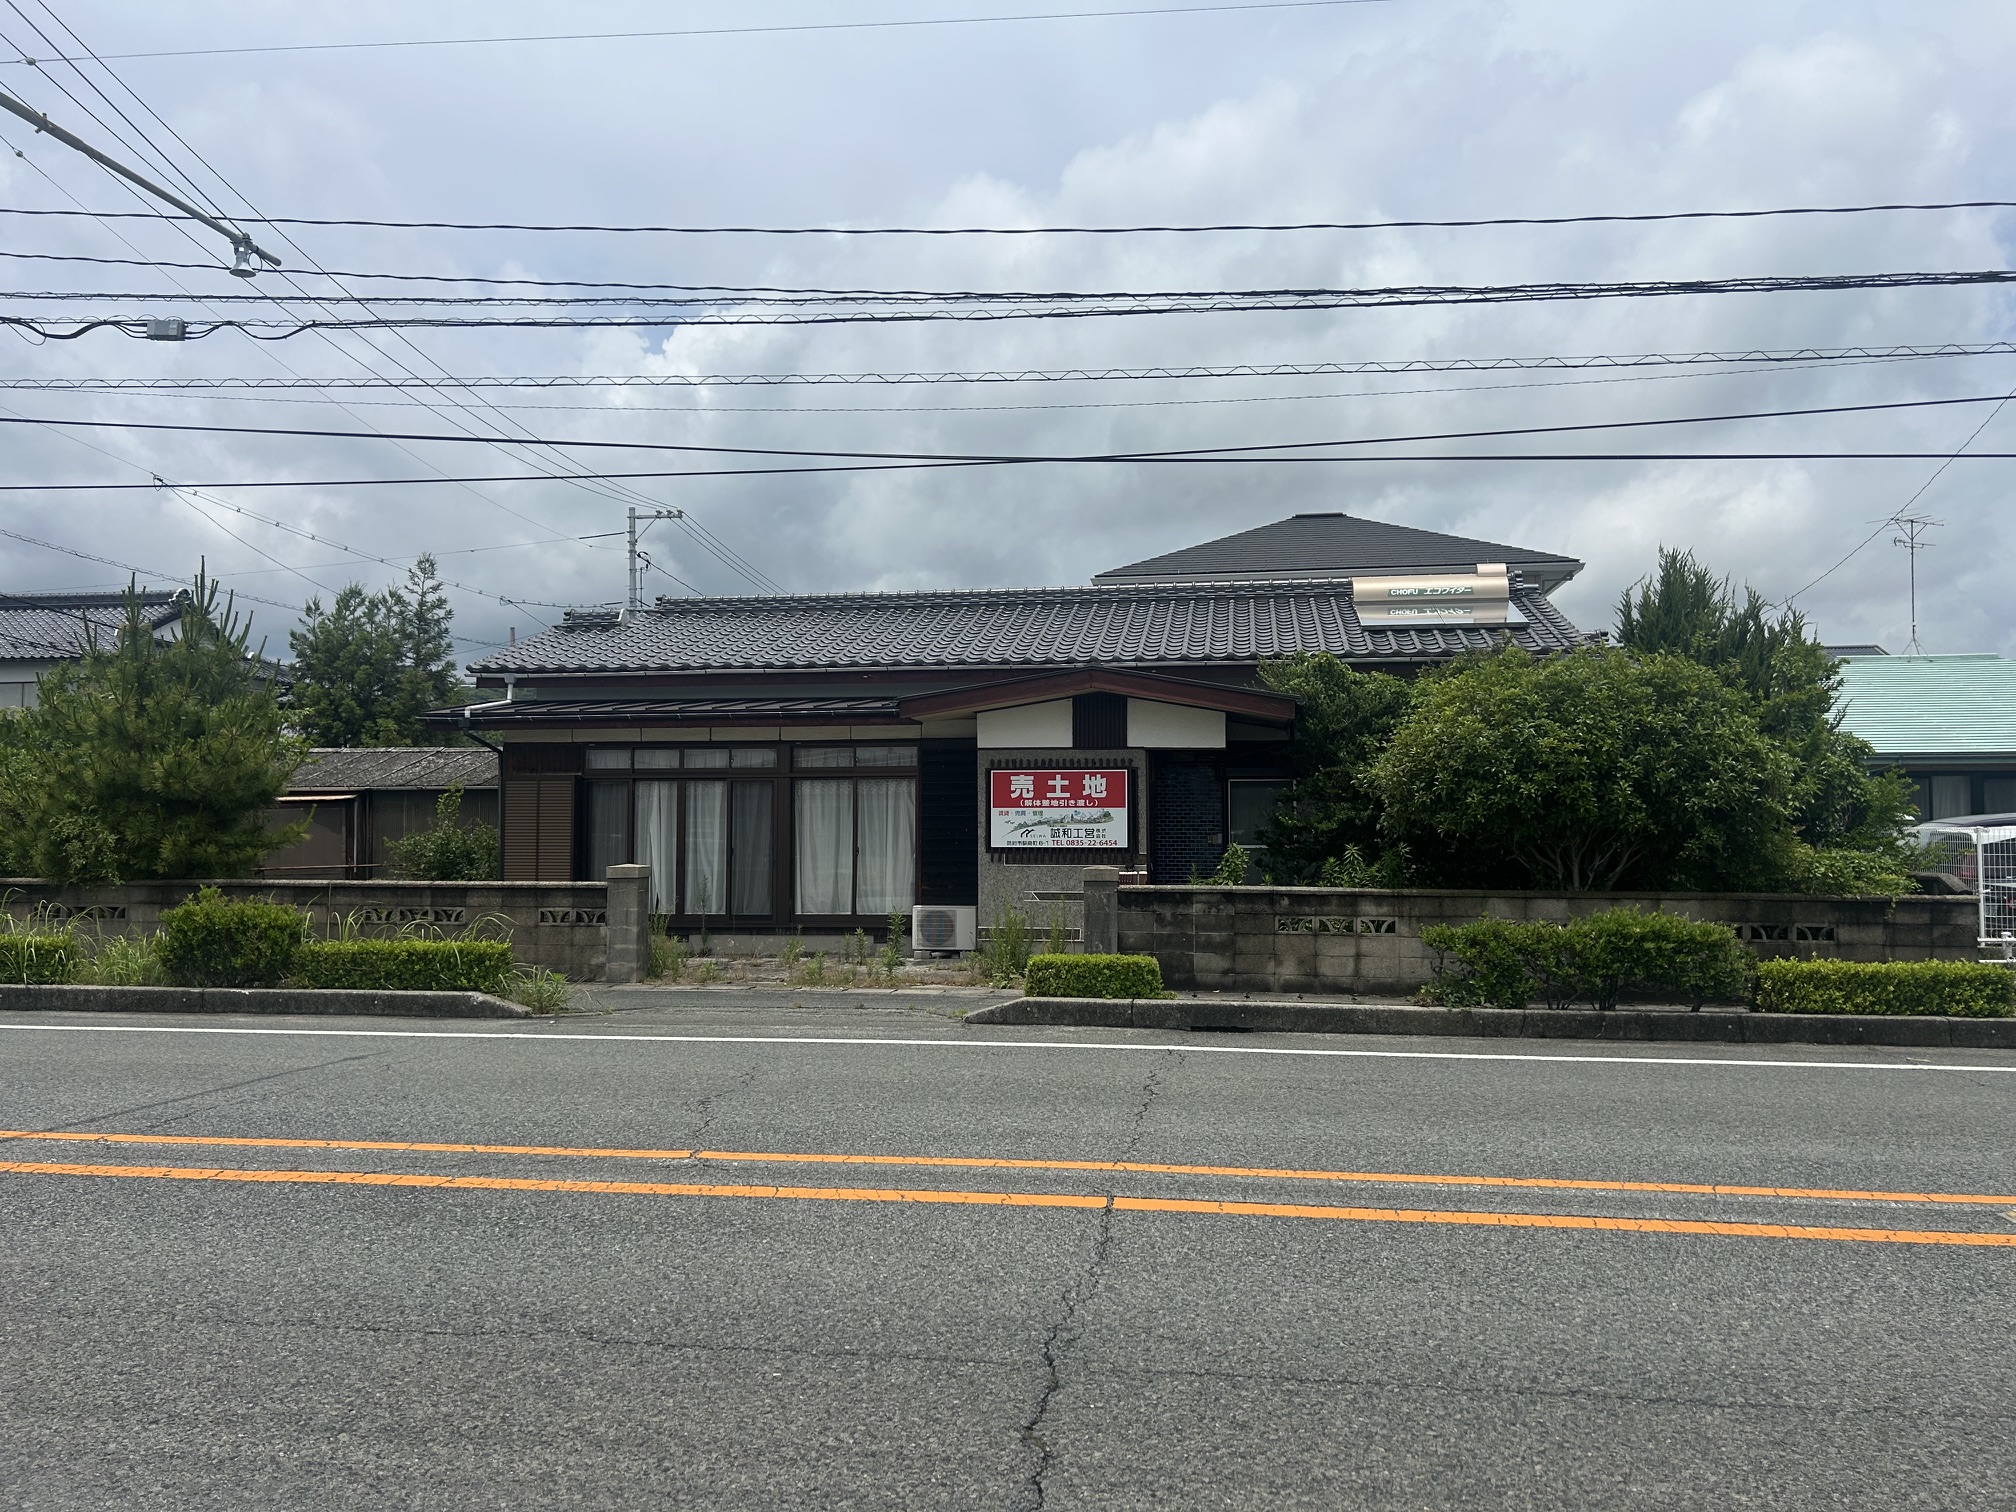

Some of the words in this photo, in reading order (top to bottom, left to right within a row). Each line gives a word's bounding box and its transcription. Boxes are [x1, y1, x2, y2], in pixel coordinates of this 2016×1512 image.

[1390, 588, 1419, 596] CHOFU
[1010, 774, 1107, 798] 売土地
